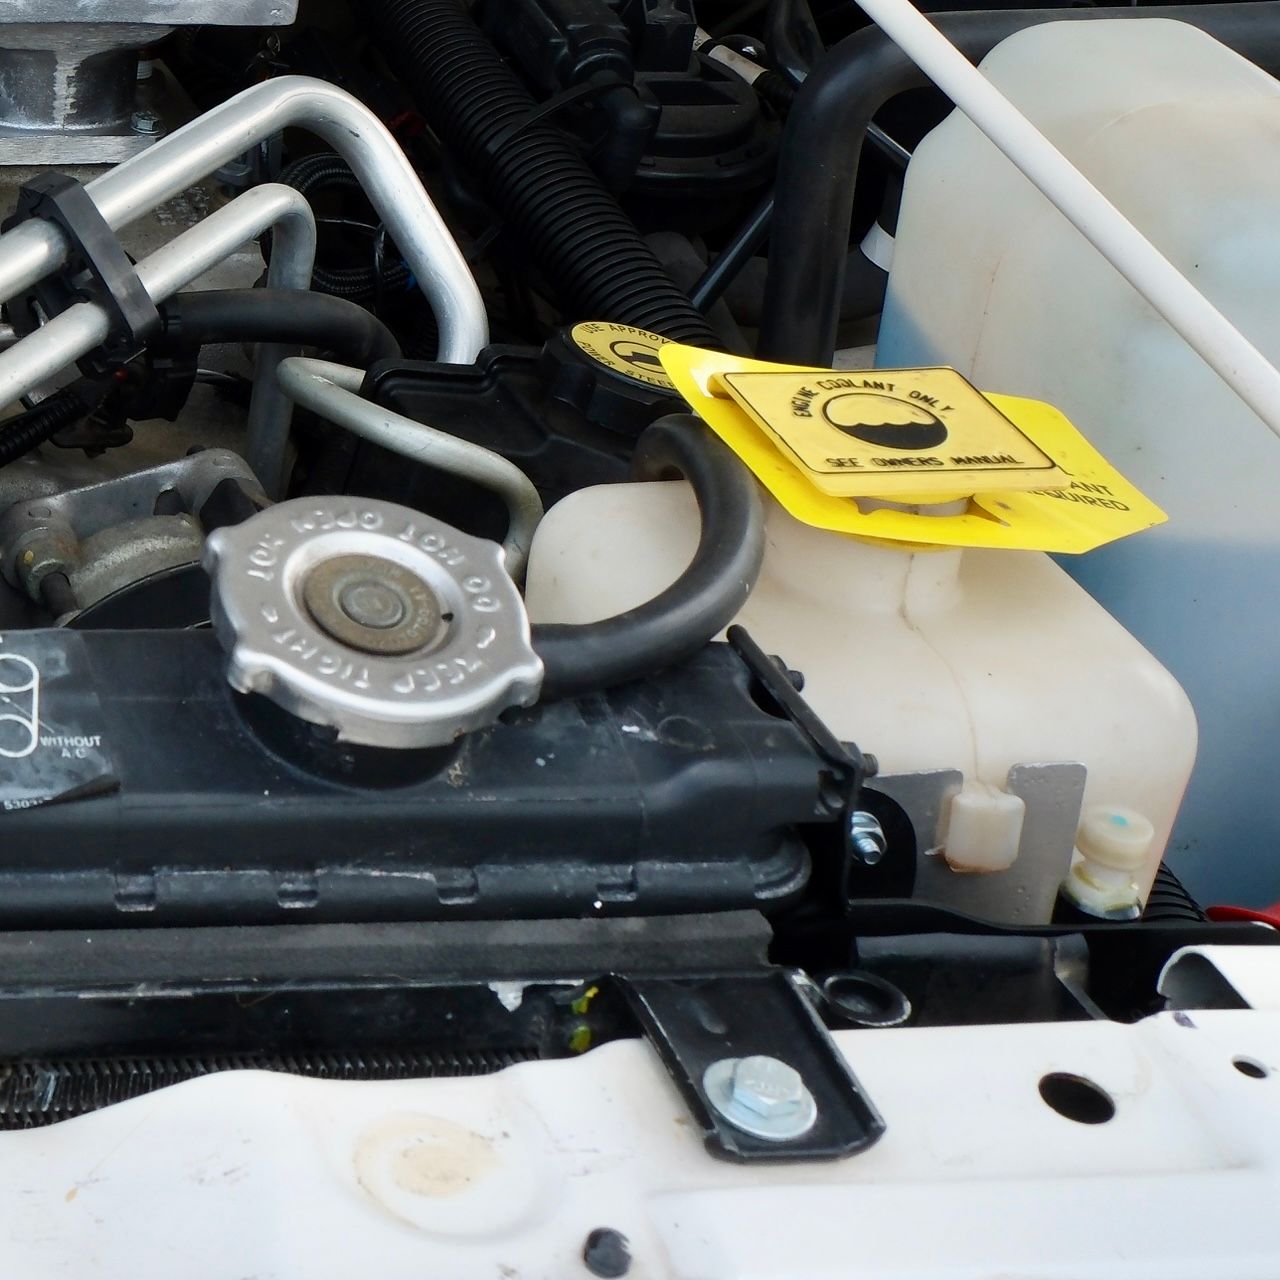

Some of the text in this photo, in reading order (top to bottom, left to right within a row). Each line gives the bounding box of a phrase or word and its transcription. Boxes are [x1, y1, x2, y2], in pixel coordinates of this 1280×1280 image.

[608, 324, 675, 346] APPROV
[792, 377, 955, 418] ENGINE COOLANT ONLY
[824, 453, 1024, 468] SEE OWNERS MANUAL
[1026, 489, 1130, 511] QUIRED
[40, 735, 102, 748] WITHOUT
